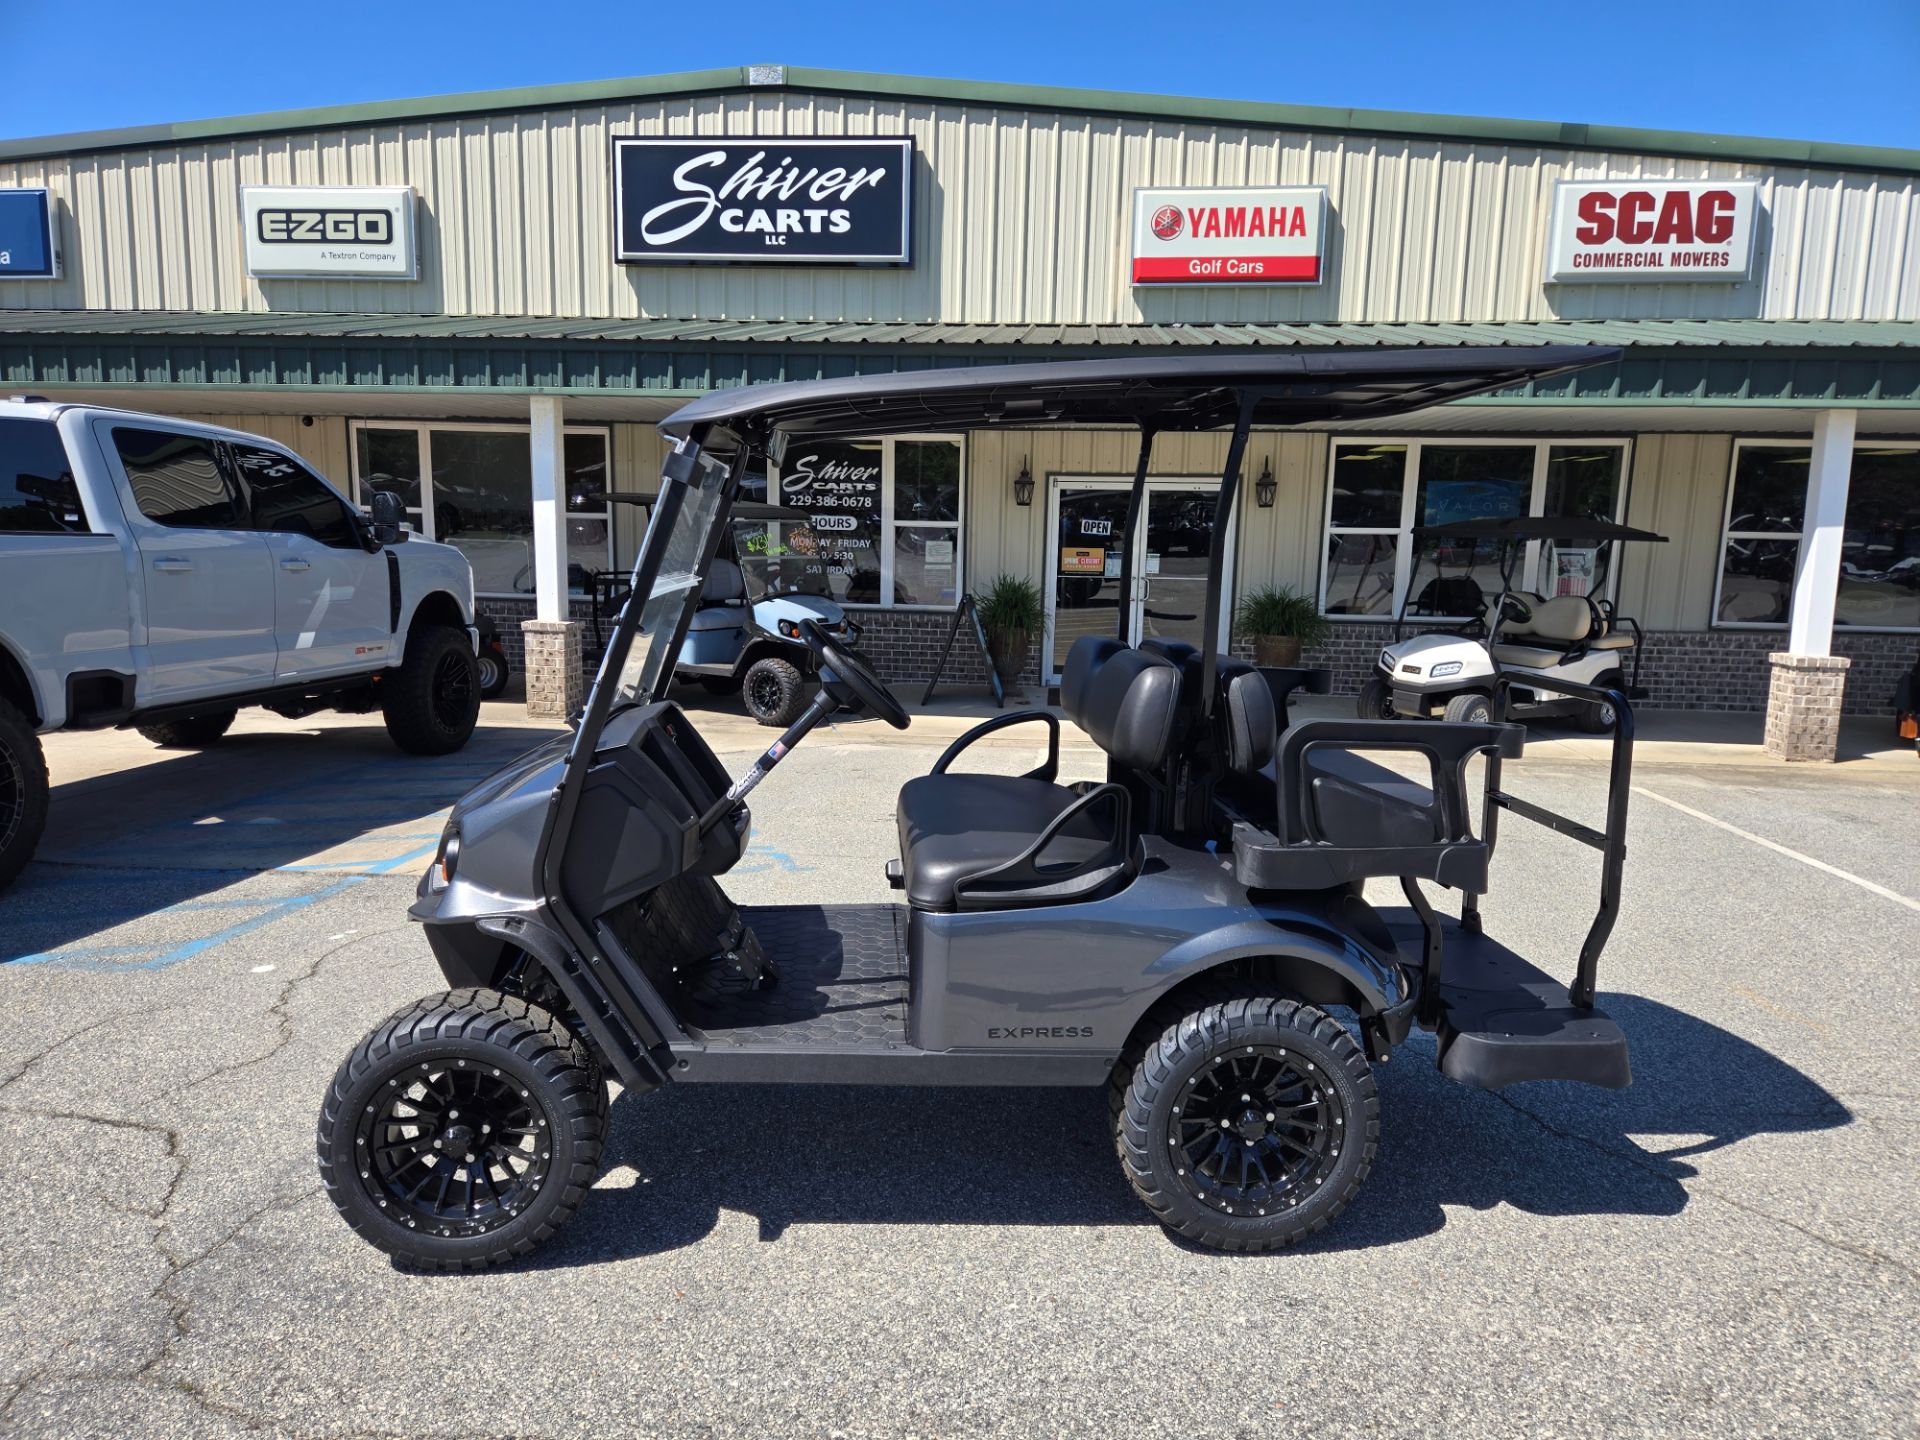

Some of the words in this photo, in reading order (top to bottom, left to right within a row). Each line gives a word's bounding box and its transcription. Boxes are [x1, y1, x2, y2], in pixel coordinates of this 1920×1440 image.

[641, 151, 886, 245] Shiver
[719, 209, 851, 233] CARTS
[1187, 206, 1307, 238] YAMAHA
[1576, 190, 1737, 245] SCAG
[765, 235, 786, 245] LLC
[329, 252, 357, 260] Textron
[360, 252, 396, 261] Company
[1573, 252, 1664, 268] COMMERCIAL
[1670, 252, 1730, 267] MOWERS
[1189, 259, 1222, 274] Golf
[1227, 259, 1264, 274] Cars
[783, 455, 879, 492] Shiver
[812, 482, 877, 490] CARTS
[789, 495, 872, 507] 229-386-0678
[1438, 499, 1511, 512] VALOR
[1083, 521, 1110, 534] OPEN
[790, 537, 831, 547] MONAY
[838, 538, 871, 548] FRIDAY
[834, 551, 854, 560] 5:30
[988, 1026, 1094, 1039] EXPRESS
